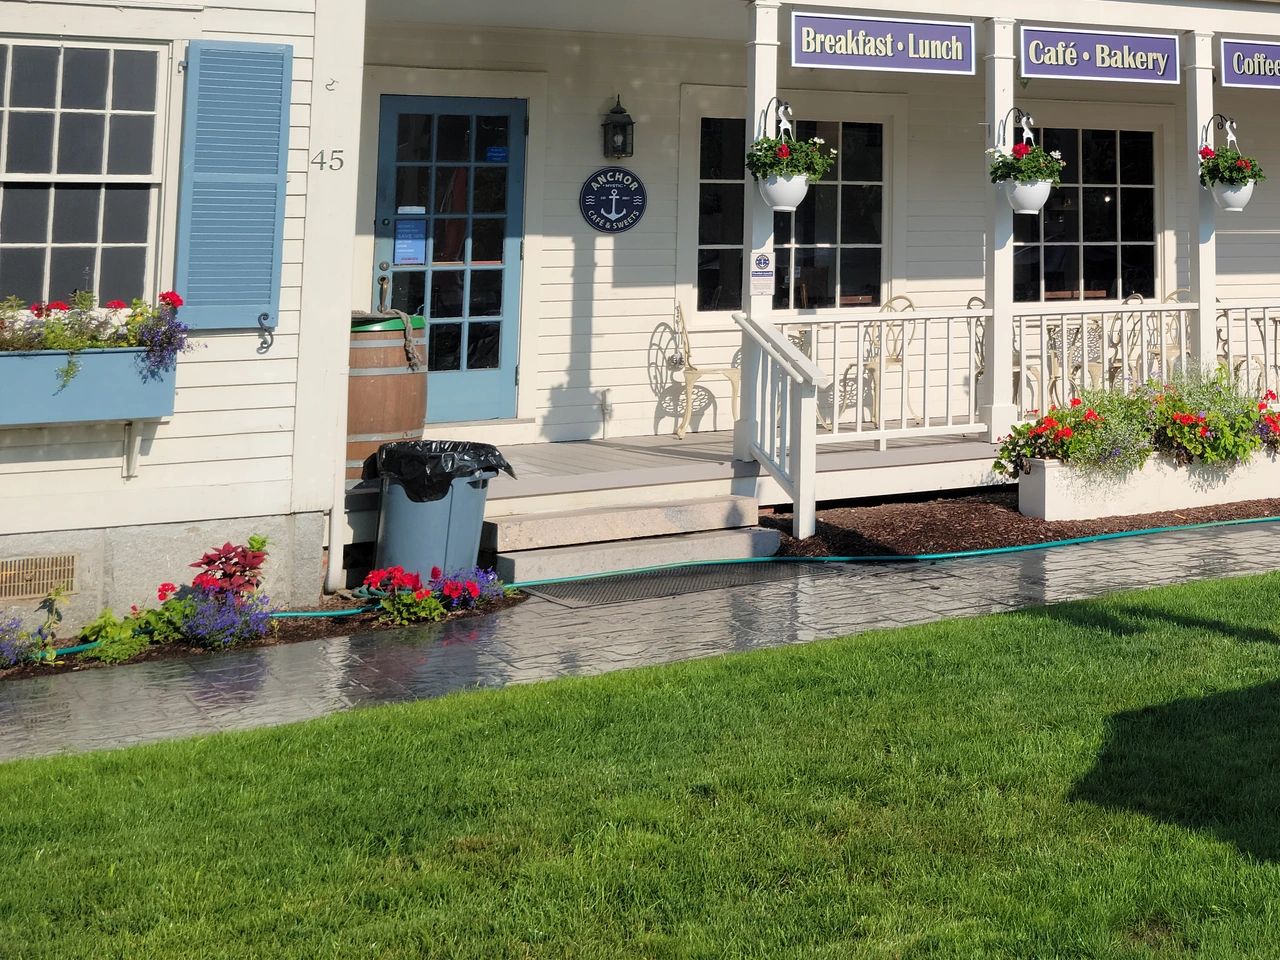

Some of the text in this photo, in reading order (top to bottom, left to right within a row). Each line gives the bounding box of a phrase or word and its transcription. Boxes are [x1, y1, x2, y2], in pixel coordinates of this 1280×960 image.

[801, 26, 963, 60] Breakfast Lunch
[1029, 40, 1168, 76] Café Bakery
[310, 149, 344, 171] 45
[591, 172, 639, 191] ANCHOR
[612, 210, 639, 229] SWEETS
